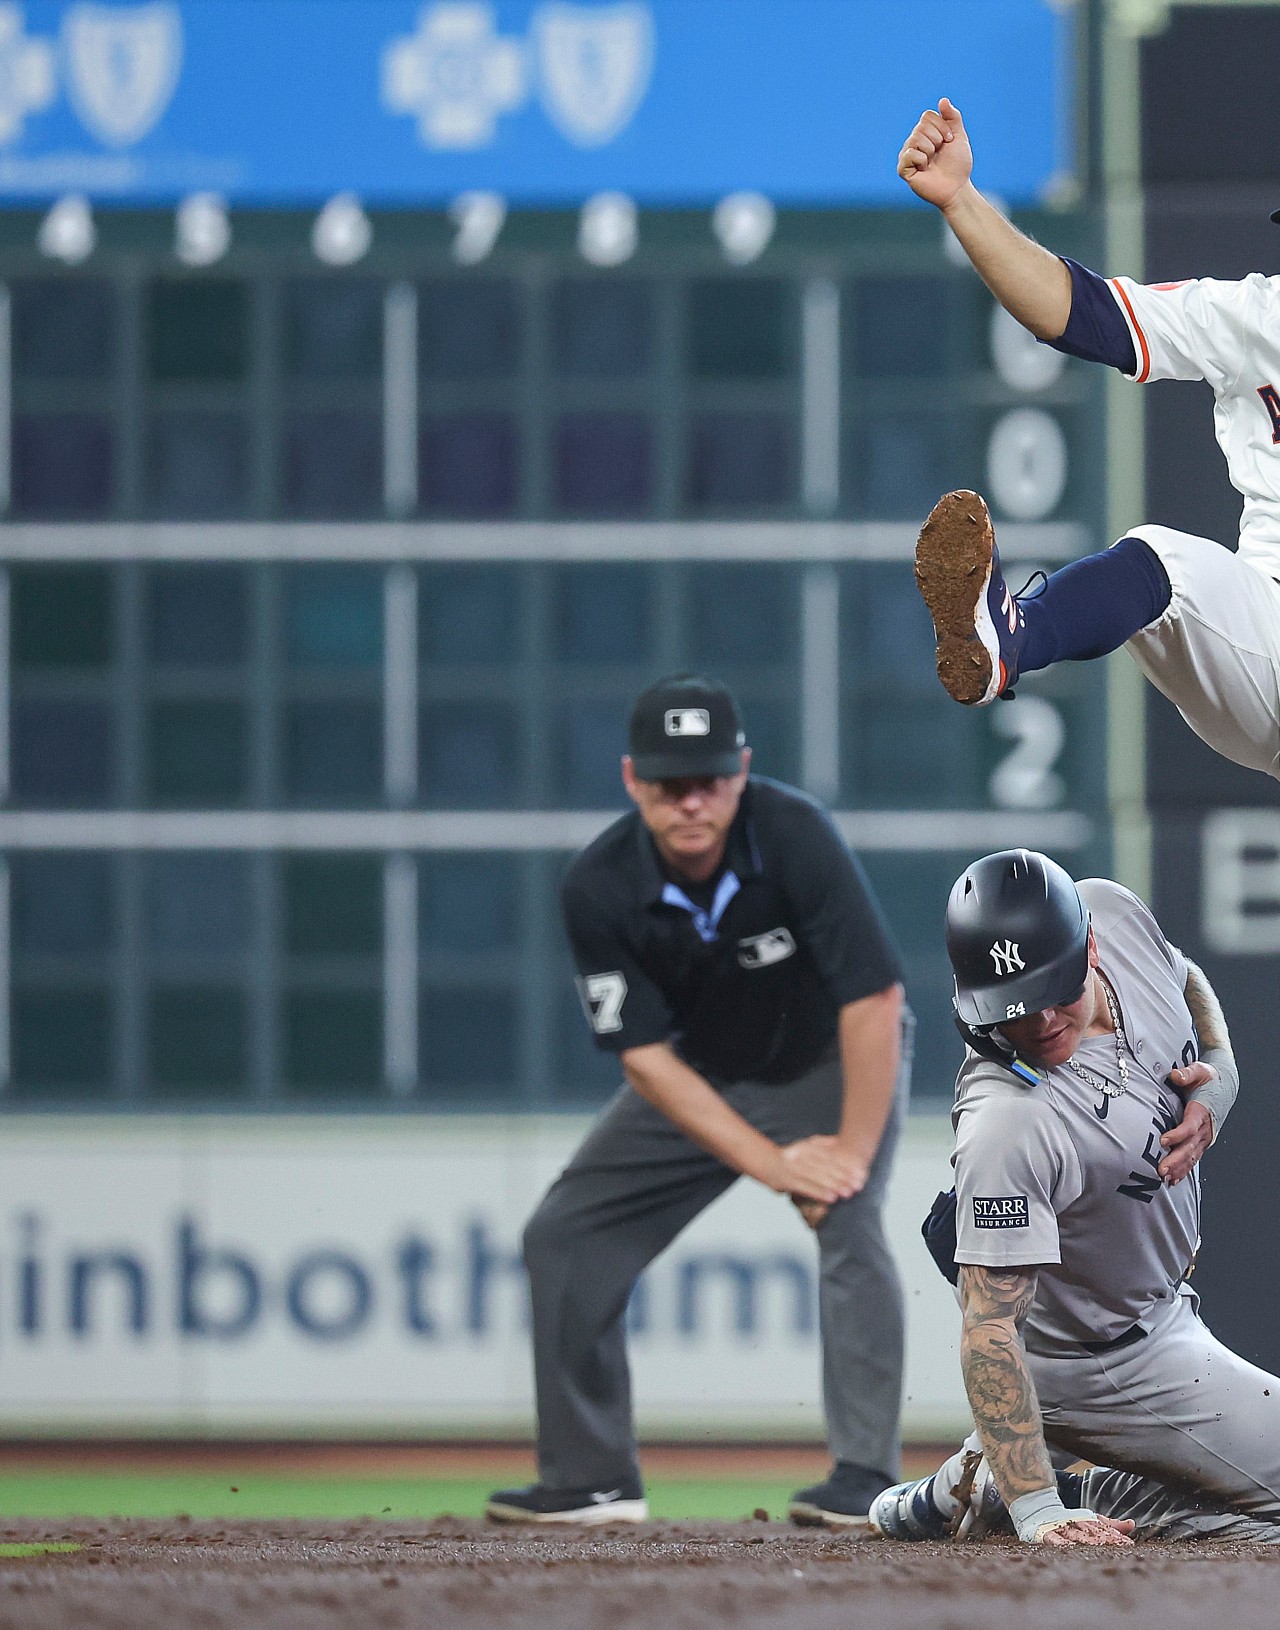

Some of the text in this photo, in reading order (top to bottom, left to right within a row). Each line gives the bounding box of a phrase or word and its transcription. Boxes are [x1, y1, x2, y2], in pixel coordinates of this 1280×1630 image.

[449, 190, 505, 266] 7
[712, 190, 777, 266] 9
[987, 408, 1067, 519] 0
[990, 696, 1068, 808] 2
[989, 939, 1026, 976] NY
[1006, 1001, 1026, 1019] 24
[974, 1199, 1027, 1216] STARR
[976, 1218, 1026, 1227] INSURANCE
[16, 1208, 818, 1340] inbothm
